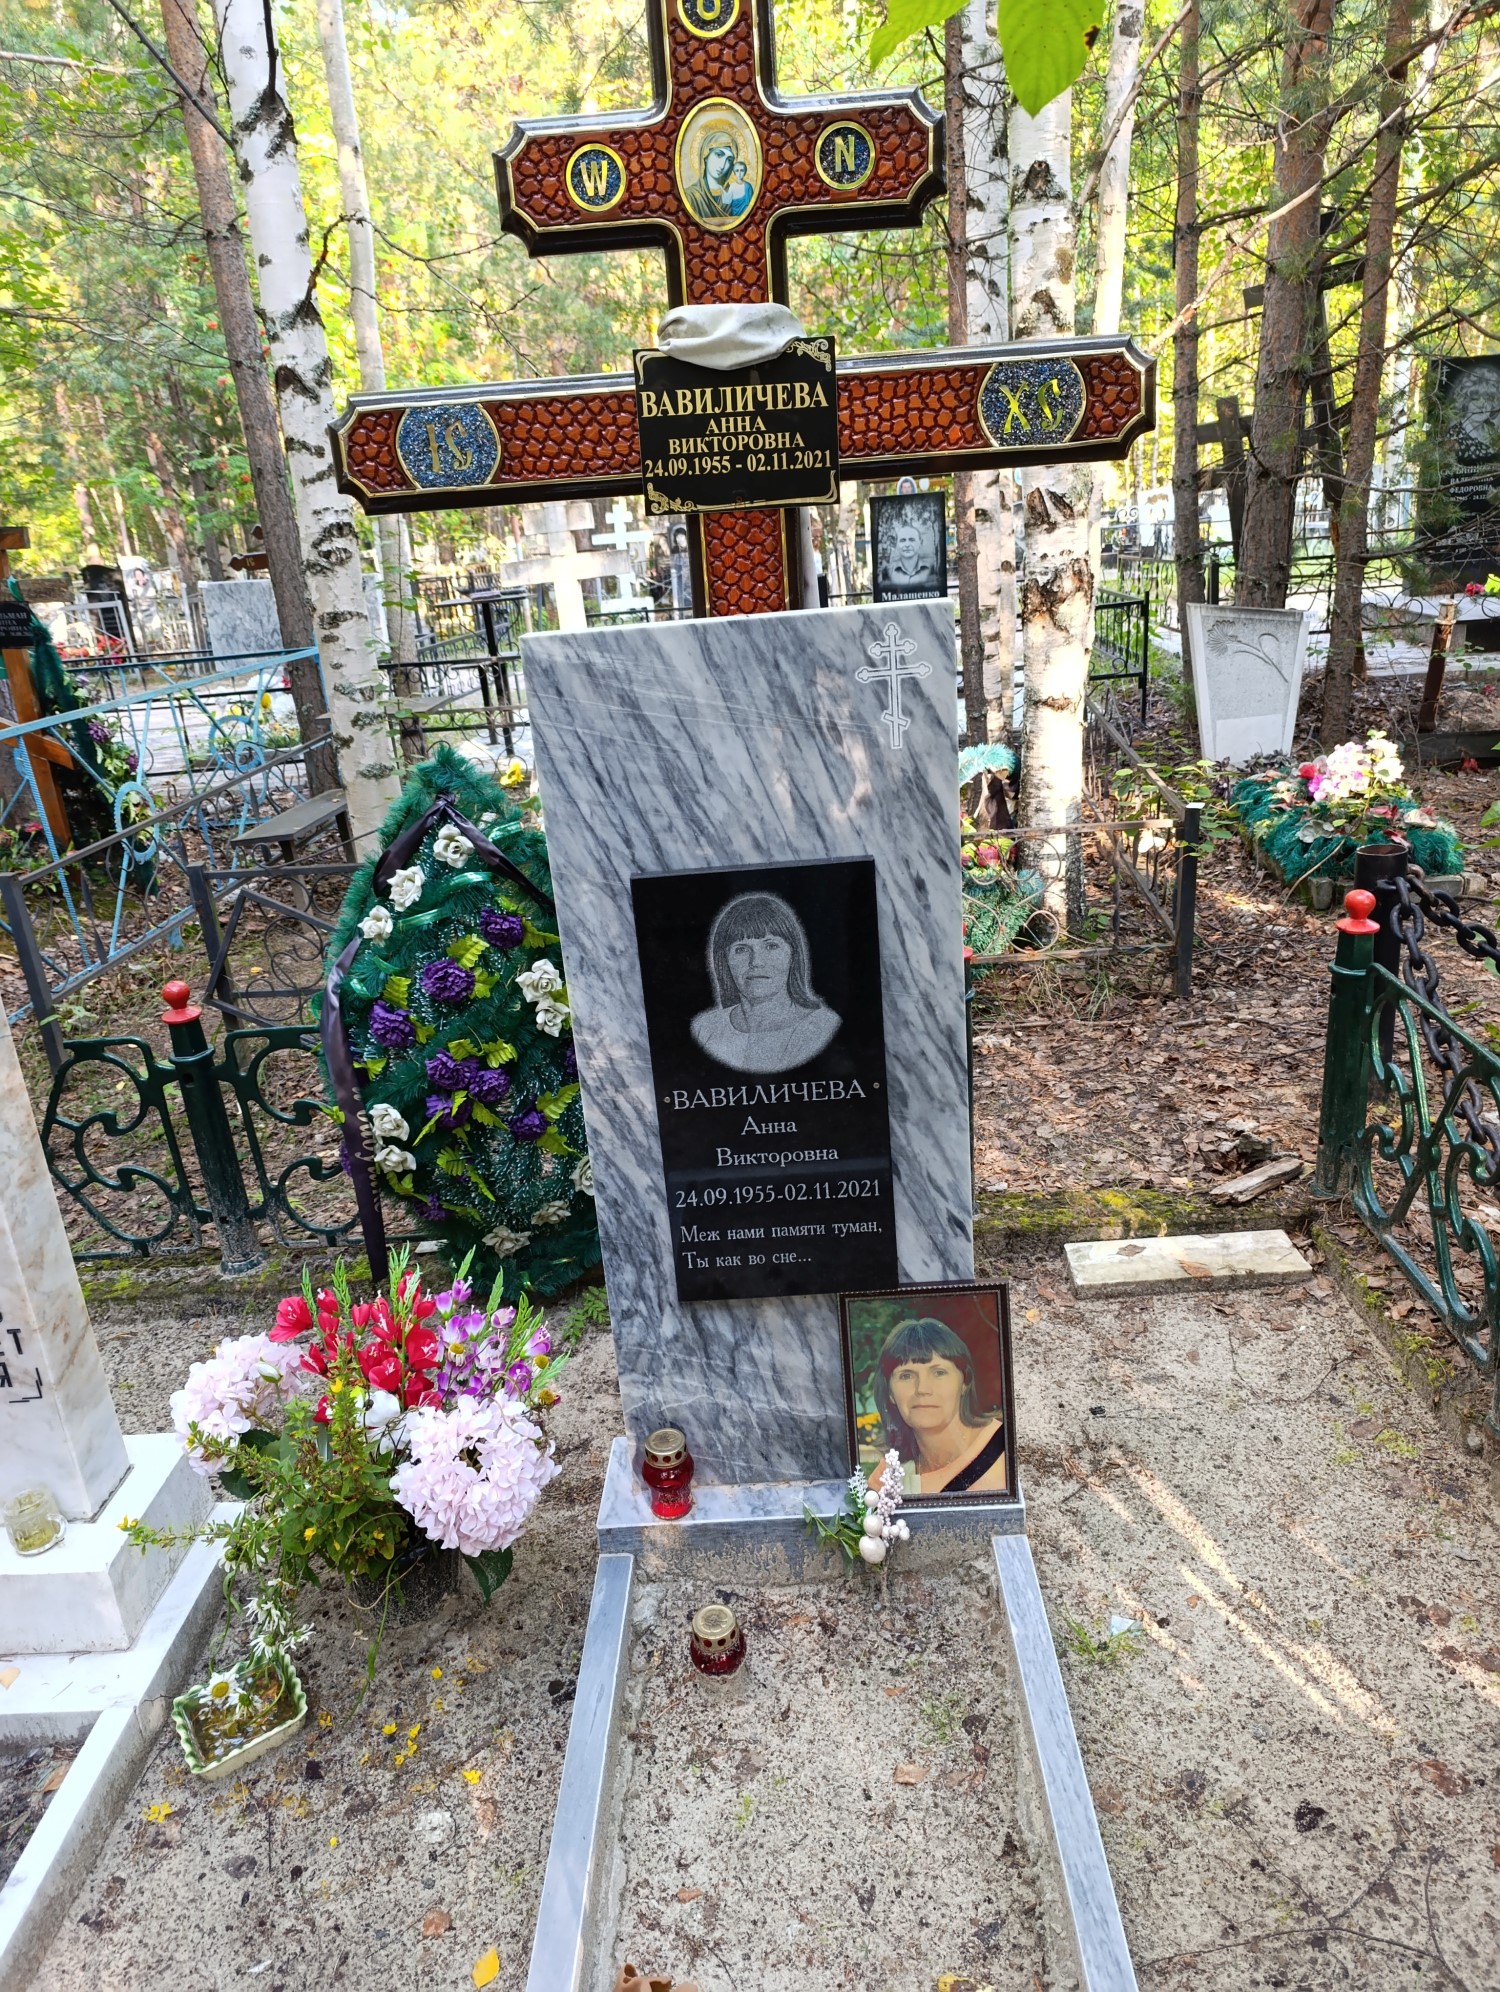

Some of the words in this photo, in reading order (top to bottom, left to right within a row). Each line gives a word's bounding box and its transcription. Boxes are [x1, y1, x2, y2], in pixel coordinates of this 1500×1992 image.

[835, 135, 855, 172] N
[580, 160, 608, 196] W
[640, 381, 829, 418] ВАВИЛИЧЕВА
[705, 415, 767, 435] АННА
[668, 432, 805, 455] ВИКТОРОВНА
[644, 455, 731, 478] 24.09.1955
[747, 450, 831, 472] 02.11.2021
[672, 1079, 867, 1110] ВАВИЛИЧЕВА
[740, 1116, 798, 1136] Анна
[715, 1147, 839, 1167] Викторовна
[675, 1179, 881, 1208] 24.09.1955-02.11.2021
[680, 1225, 720, 1243] Меж
[727, 1229, 765, 1240] нами
[771, 1224, 826, 1238] памяти
[832, 1221, 883, 1237] туман,
[682, 1251, 710, 1269] Ты
[716, 1256, 741, 1267] как
[748, 1254, 766, 1265] во
[772, 1252, 812, 1264] сне...
